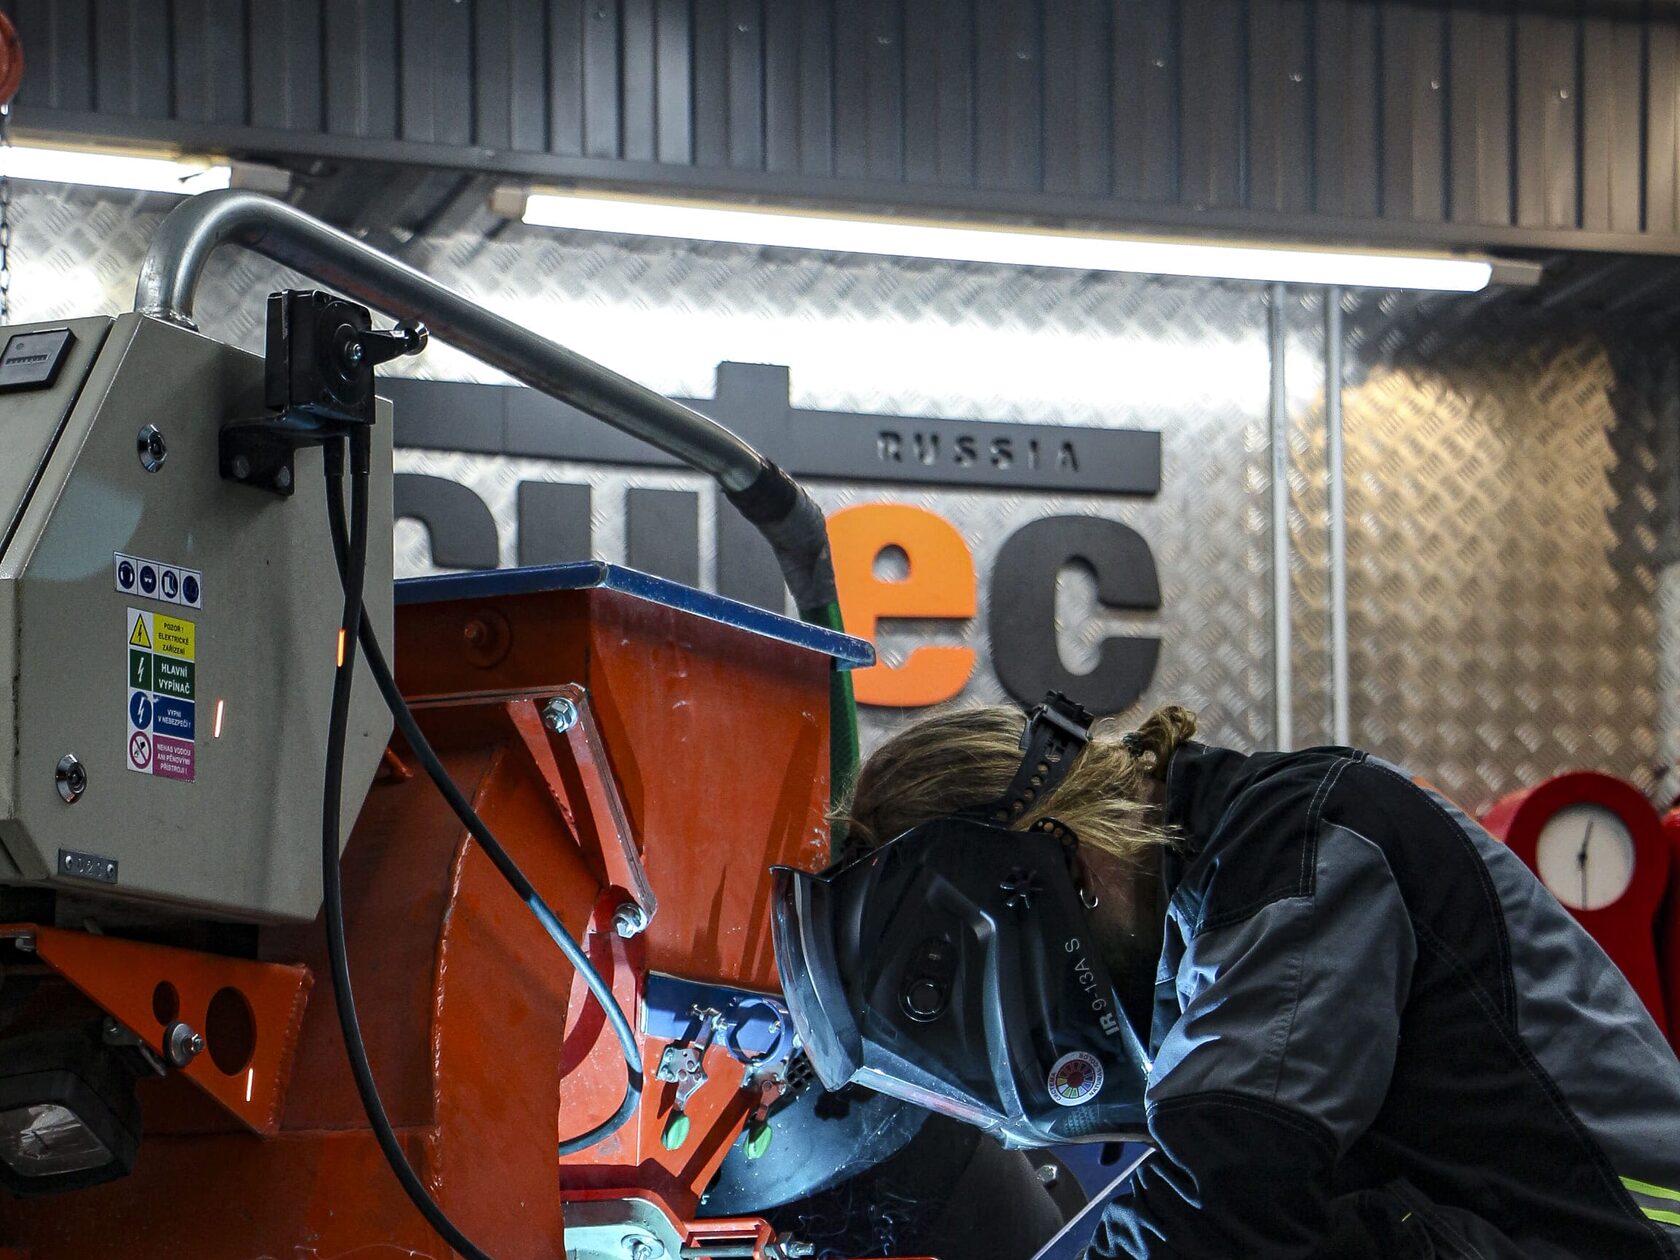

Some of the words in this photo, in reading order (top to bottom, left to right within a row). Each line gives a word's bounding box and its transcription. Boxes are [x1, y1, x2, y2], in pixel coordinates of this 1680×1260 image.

[877, 430, 1080, 473] RUSSIA
[161, 662, 188, 678] HLAVNÍ
[158, 678, 190, 694] VYPÍNAČ
[1064, 938, 1080, 953] S
[1074, 957, 1107, 1011] 9-13A
[1099, 1012, 1120, 1036] IR
